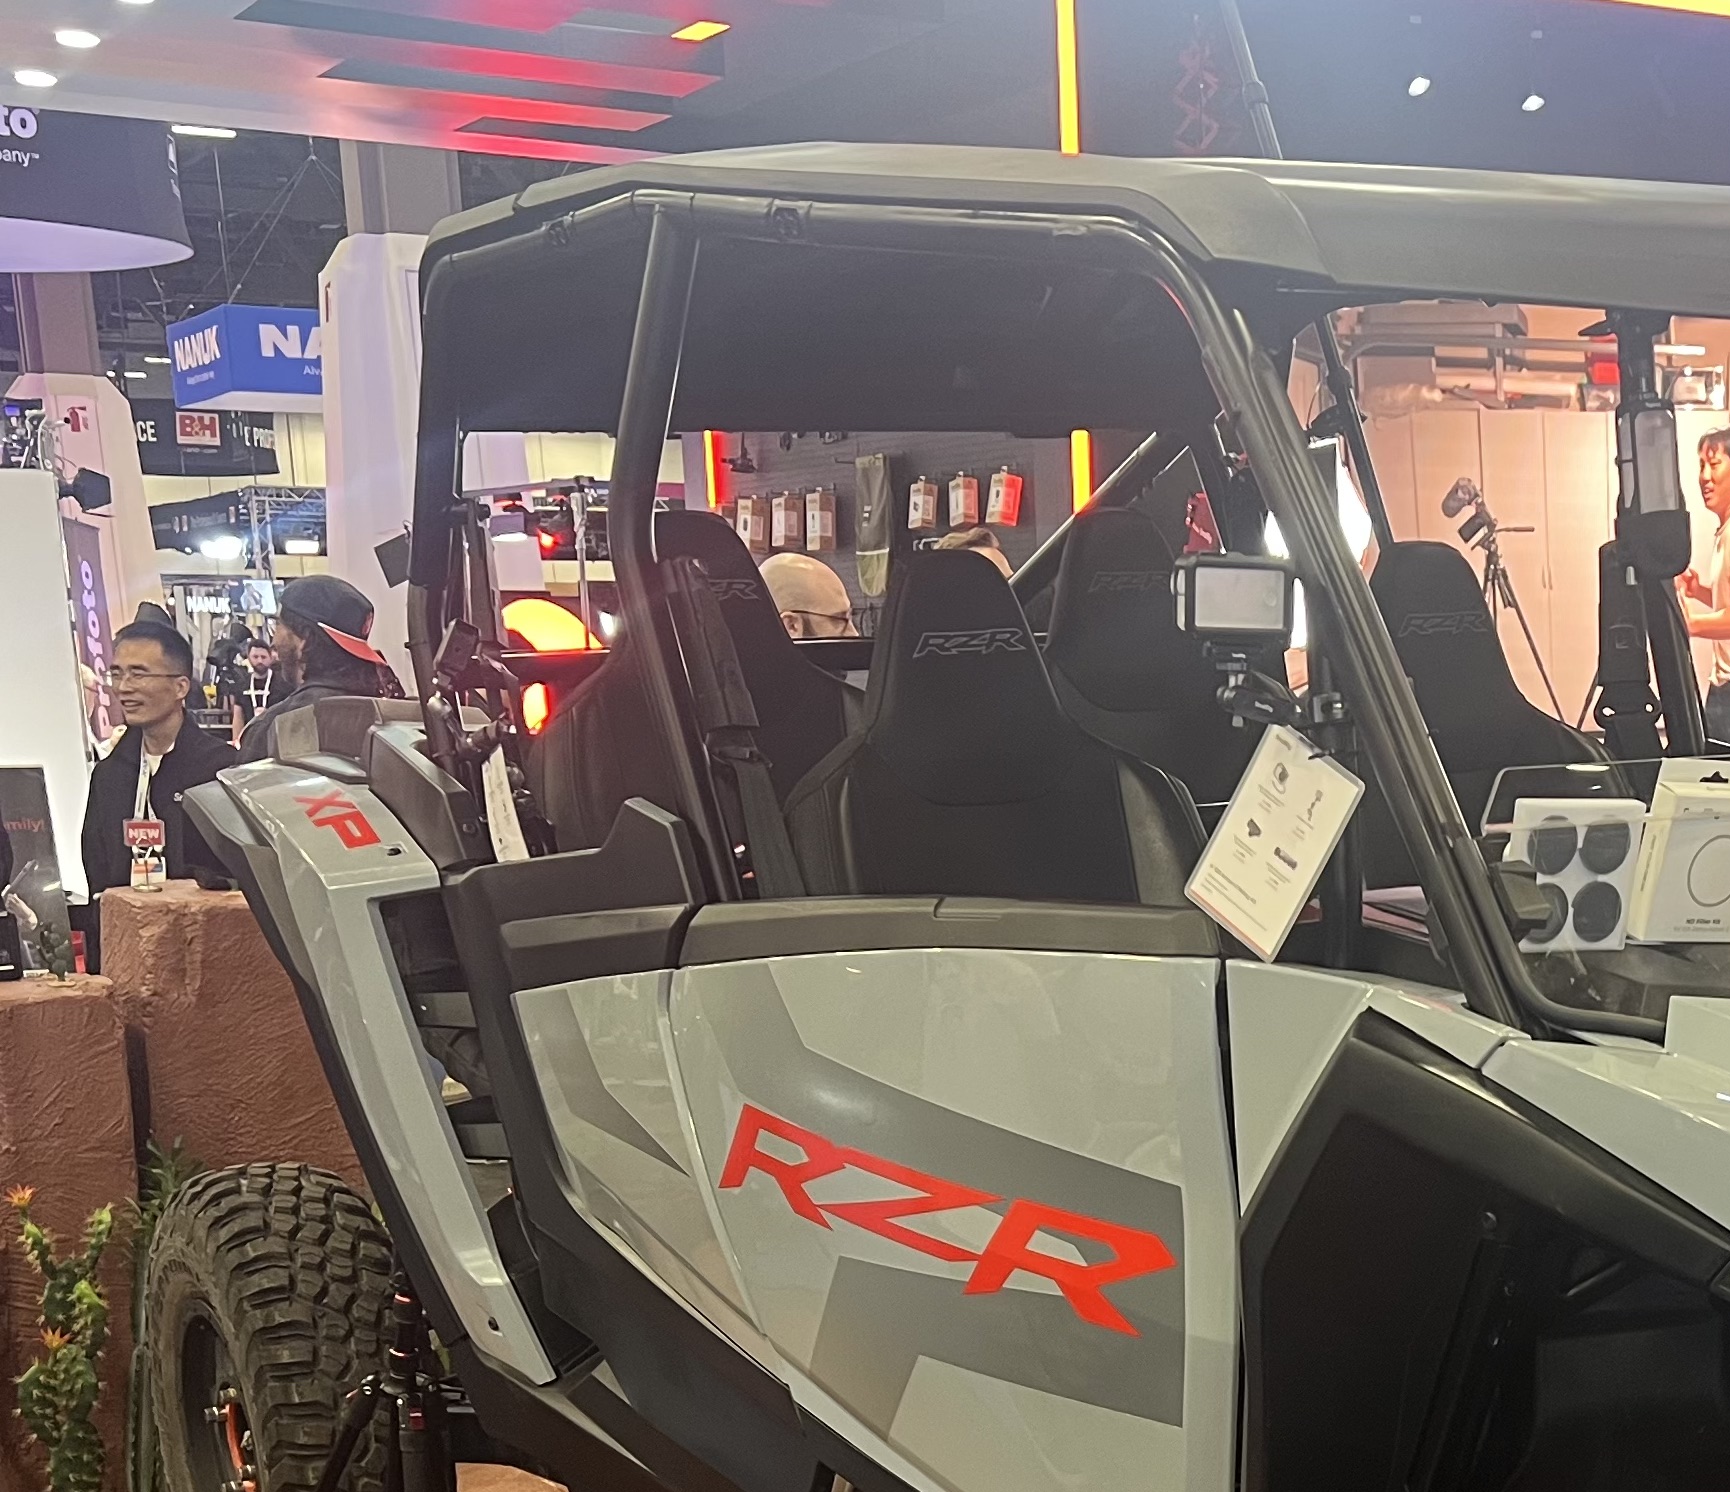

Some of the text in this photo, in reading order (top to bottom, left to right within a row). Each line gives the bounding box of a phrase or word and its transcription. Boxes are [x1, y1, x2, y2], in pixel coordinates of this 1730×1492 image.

[174, 325, 221, 372] NANUK
[179, 415, 217, 438] B&H
[912, 629, 1027, 658] RZR
[128, 828, 160, 839] NEW
[294, 790, 382, 850] XP
[718, 1102, 1177, 1338] RZR
